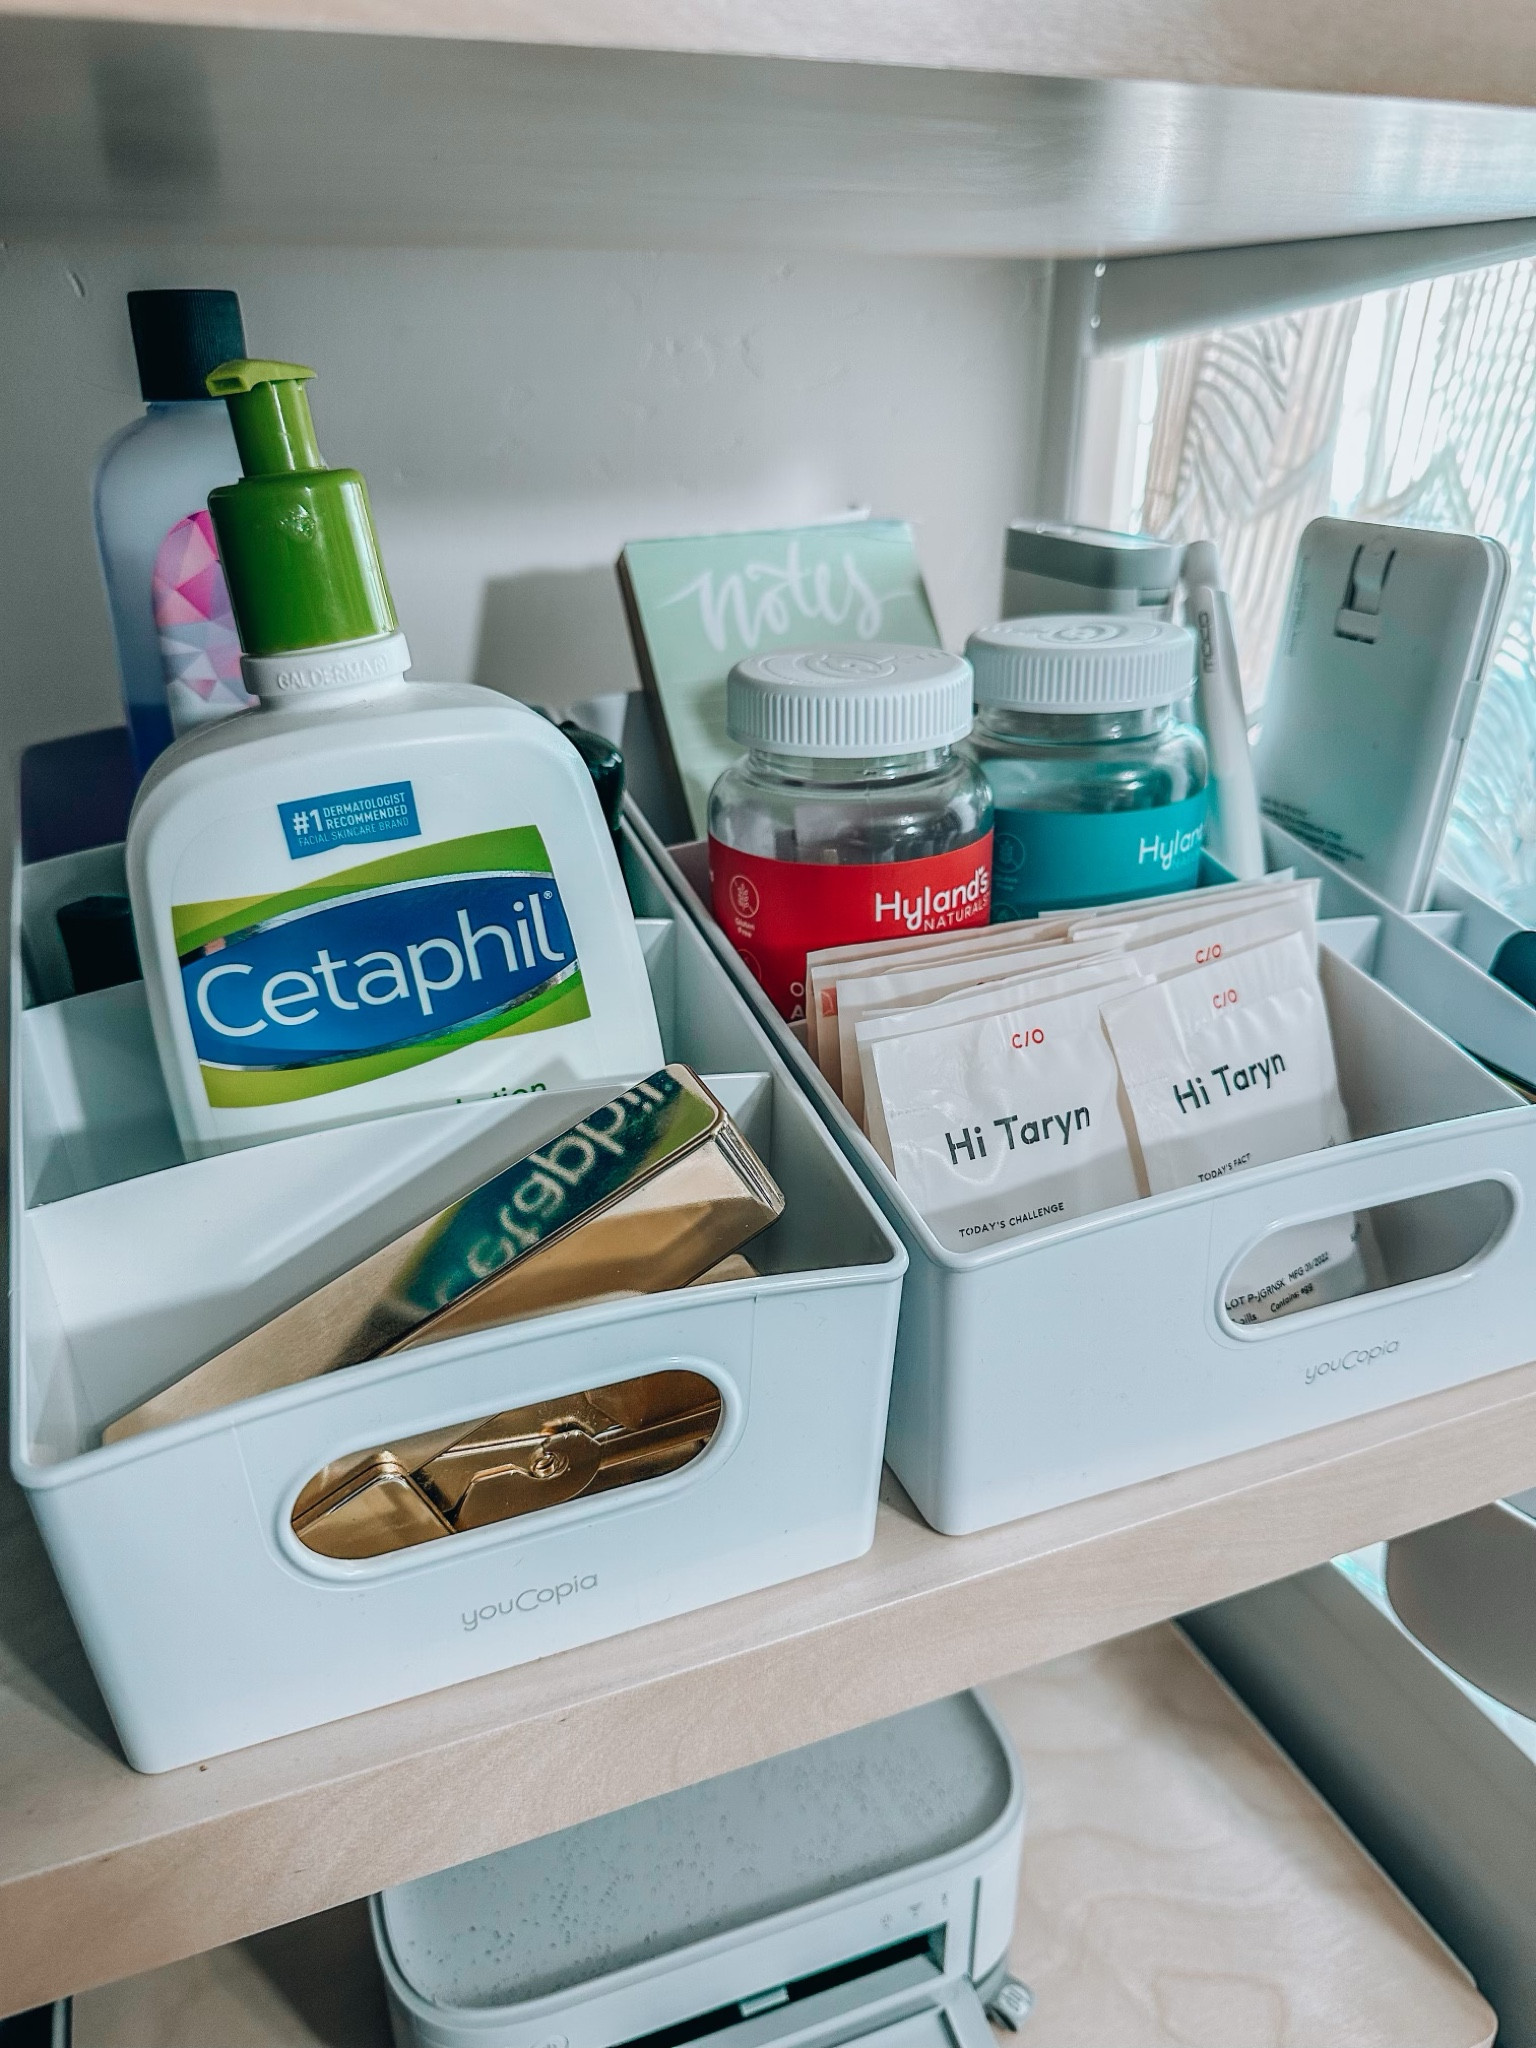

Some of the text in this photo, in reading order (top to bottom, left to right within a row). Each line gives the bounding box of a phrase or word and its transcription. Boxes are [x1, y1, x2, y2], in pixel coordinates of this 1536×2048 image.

[292, 792, 406, 836] #1 DERMATOLOGIST
[299, 816, 409, 847] FACIAL SKINCARE BRAND
[325, 805, 408, 830] RECOMMENDED
[875, 865, 989, 931] Hyland's
[923, 891, 990, 932] NATURALS
[1195, 944, 1221, 964] C/O
[1213, 988, 1237, 1009] C/O
[1012, 1028, 1044, 1048] C/O
[1173, 1052, 1286, 1114] Hi Taryn
[945, 1105, 1090, 1165] Hi Taryn
[1197, 1152, 1251, 1182] TODAY'S FACT
[959, 1202, 1065, 1237] TODAY'S CHALLENGE
[1225, 1295, 1245, 1311] LOT
[1304, 1339, 1401, 1385] youCopia
[462, 1572, 599, 1632] youCopia
